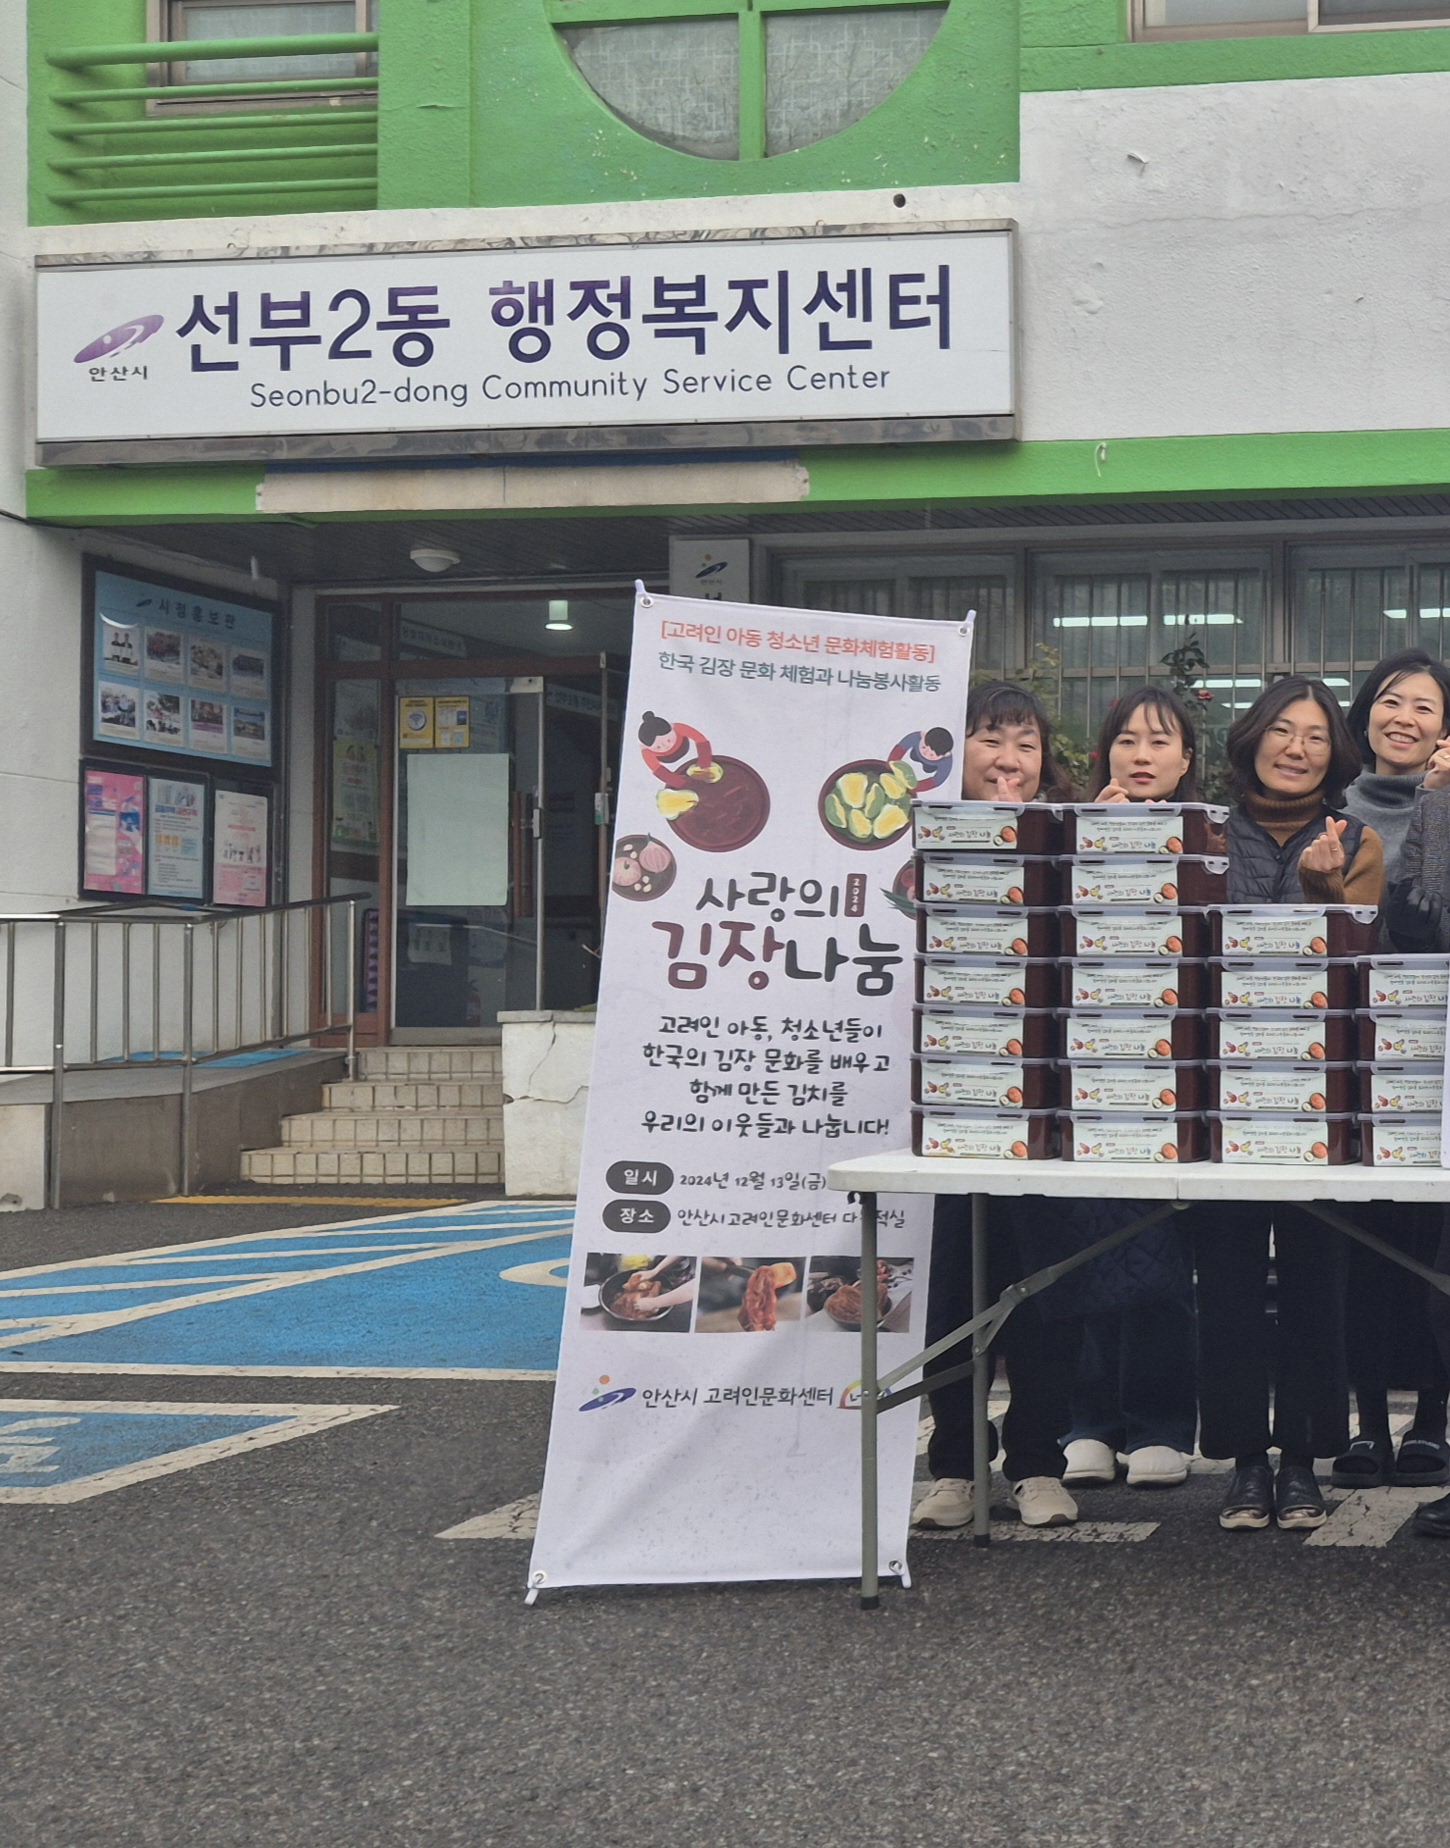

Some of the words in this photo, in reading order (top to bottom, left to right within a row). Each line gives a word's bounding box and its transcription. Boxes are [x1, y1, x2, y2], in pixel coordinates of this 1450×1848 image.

[175, 285, 450, 371] 선부2동
[490, 263, 952, 365] 행정복지센터
[88, 363, 149, 383] 안산시
[249, 376, 469, 409] Seonbu2-dong
[482, 368, 648, 402] Community
[663, 367, 772, 395] Service
[787, 363, 891, 391] Center
[660, 620, 722, 645] [고려인
[725, 627, 760, 648] 아동
[768, 630, 820, 653] 청소년
[824, 633, 936, 663] 문화체험활동]
[659, 651, 695, 674] 한국
[699, 655, 736, 678] 김장
[739, 658, 776, 680] 문화
[779, 662, 834, 686] 체험과
[836, 666, 942, 692] 나눔봉사활동
[696, 871, 838, 920] 사랑의
[849, 877, 862, 914] 2024
[658, 1015, 720, 1039] 고려인
[727, 1016, 773, 1042] 아동,
[781, 1017, 882, 1041] 청소년들이
[643, 1042, 706, 1068] 한국의
[714, 1048, 755, 1072] 김장
[764, 1048, 824, 1074] 문화를
[830, 1052, 890, 1074] 배우고
[689, 1079, 733, 1104] 함께
[738, 1081, 780, 1105] 만든
[787, 1081, 848, 1106] 김치를
[641, 1110, 705, 1133] 우리의
[711, 1113, 796, 1138] 이웃들과
[802, 1114, 890, 1139] 나눕니다!
[623, 1169, 658, 1187] 일시
[679, 1171, 729, 1189] 2024년
[735, 1171, 765, 1190] 12월
[771, 1171, 827, 1191] 13일(금)
[619, 1207, 655, 1225] 장소
[842, 1210, 906, 1228] 다적실
[642, 1388, 698, 1409] 안산시
[703, 1387, 834, 1408] 고려인문화센터
